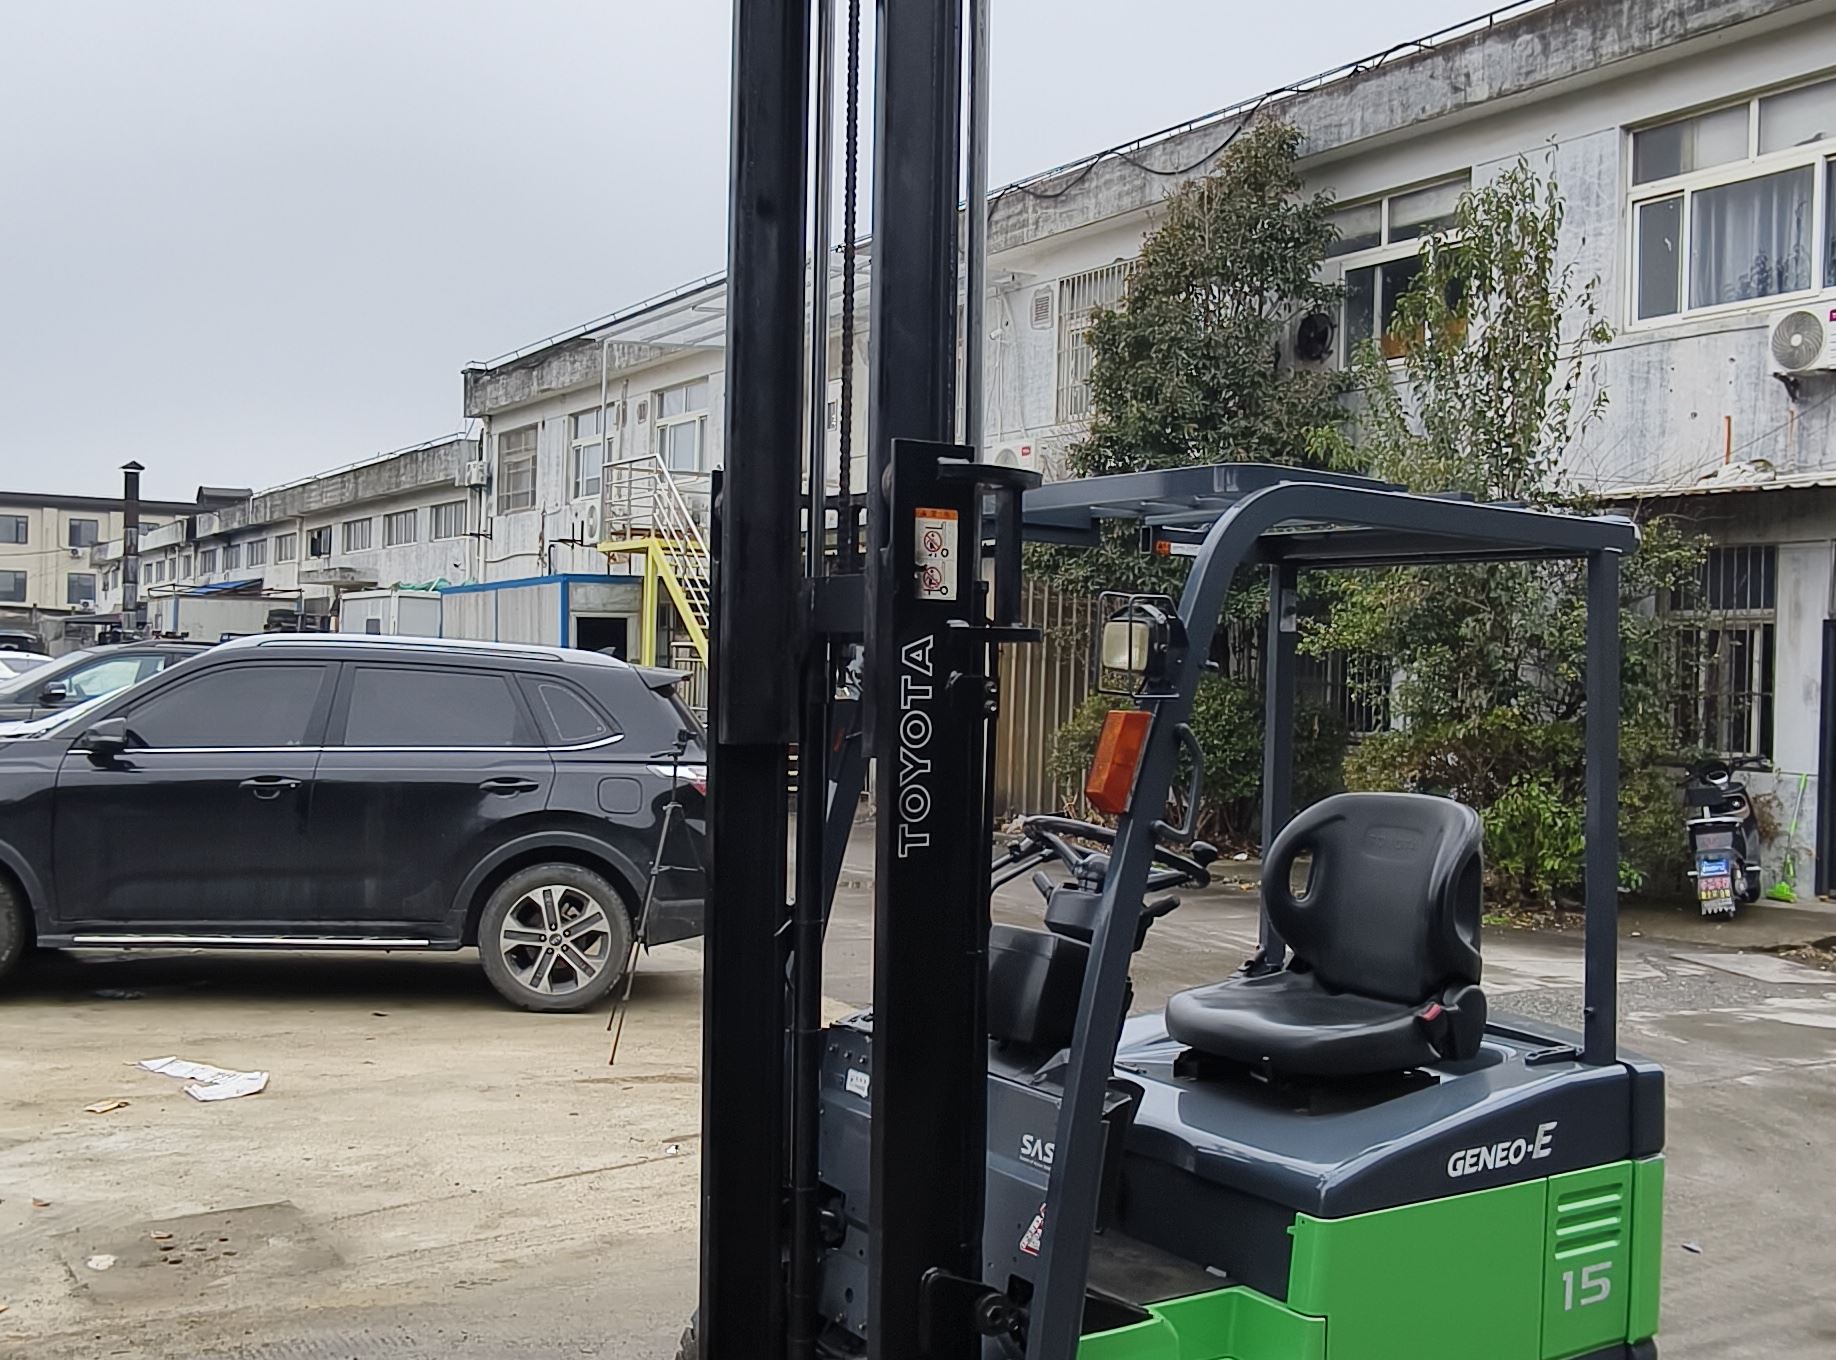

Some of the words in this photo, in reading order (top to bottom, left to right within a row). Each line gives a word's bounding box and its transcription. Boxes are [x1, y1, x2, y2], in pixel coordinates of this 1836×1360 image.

[898, 634, 934, 858] TOYOTA
[1020, 1134, 1055, 1164] SAS
[1562, 1261, 1613, 1311] 15
